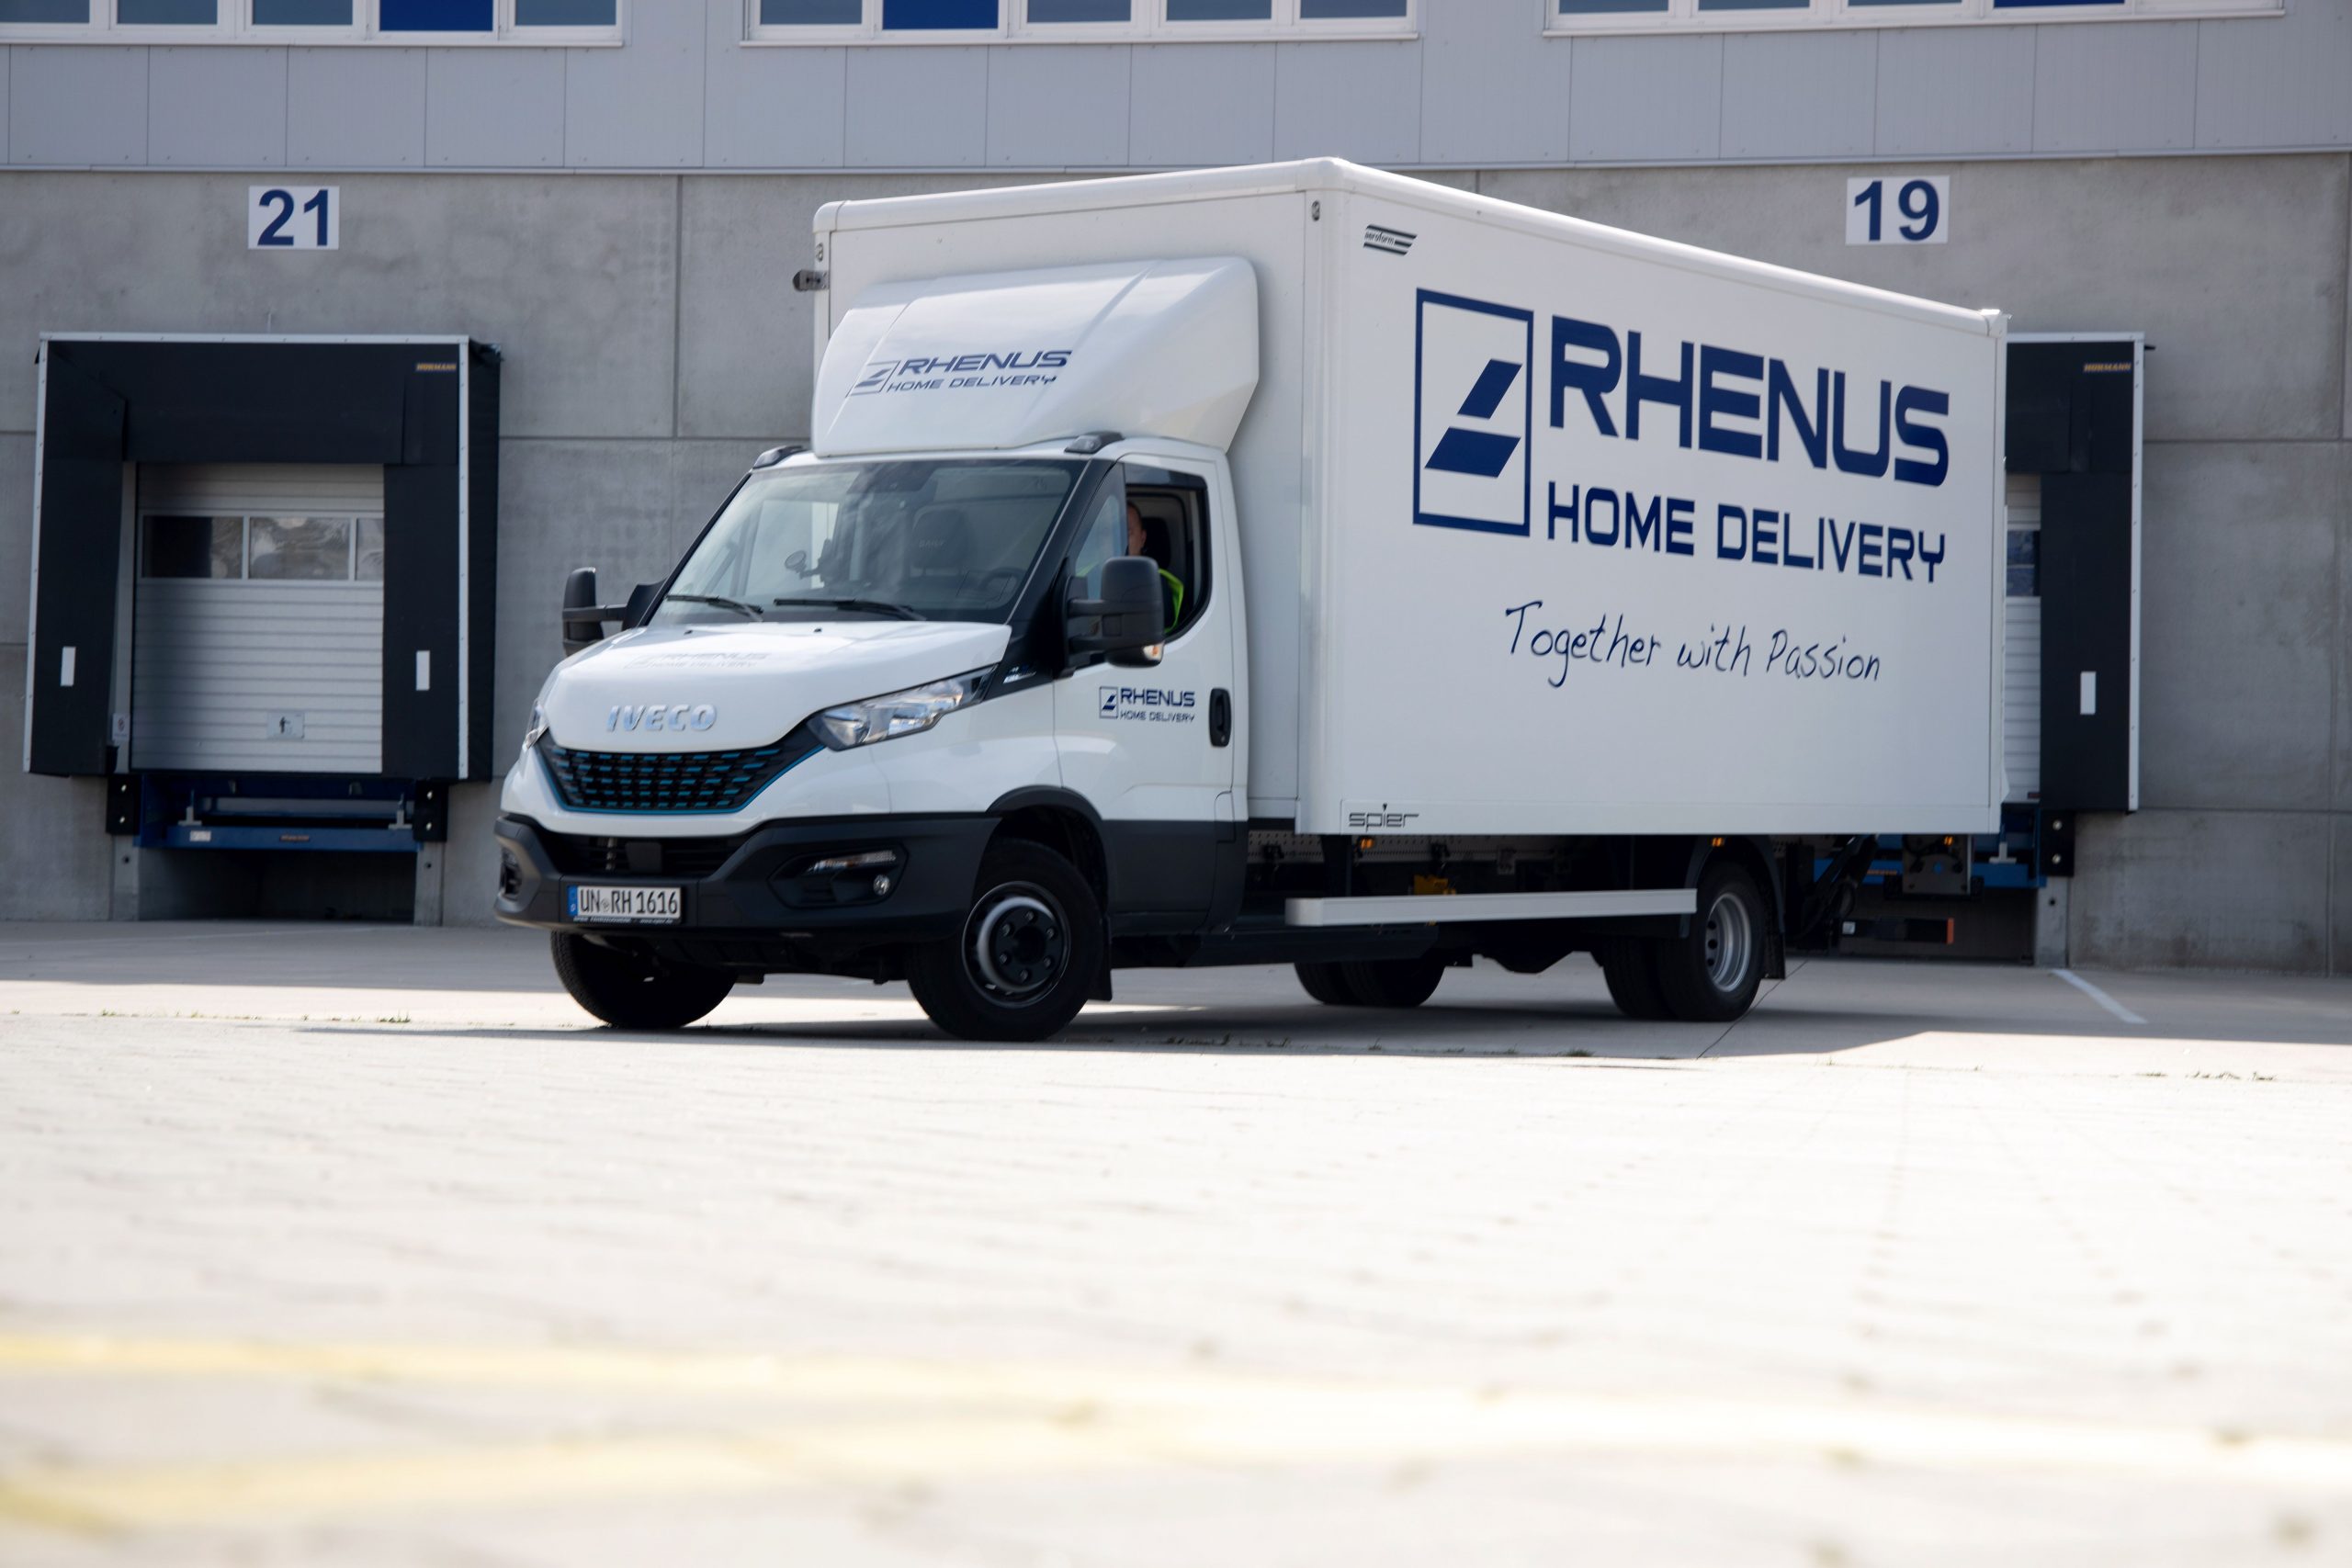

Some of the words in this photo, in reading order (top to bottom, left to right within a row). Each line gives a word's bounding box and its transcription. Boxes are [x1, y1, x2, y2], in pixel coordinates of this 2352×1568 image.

[257, 189, 328, 246] 21
[1855, 179, 1939, 242] 19
[898, 350, 1073, 376] RHENUS
[886, 378, 944, 393] HOME
[948, 375, 1057, 389] DELIVERY
[1550, 314, 1950, 487] RHENUS
[1547, 480, 1695, 556] HOME
[1716, 502, 1946, 583] DELIVERY
[1505, 600, 1662, 688] Together
[1677, 623, 1752, 677] with
[1766, 629, 1881, 682] Passion
[1120, 687, 1195, 707] RHENUS
[606, 705, 718, 732] IVECO
[1120, 710, 1147, 721] HOME
[1148, 711, 1195, 723] DELIVERY
[1349, 803, 1419, 832] spier
[580, 889, 600, 912] UN
[611, 890, 632, 913] RH
[636, 890, 678, 915] 1616
